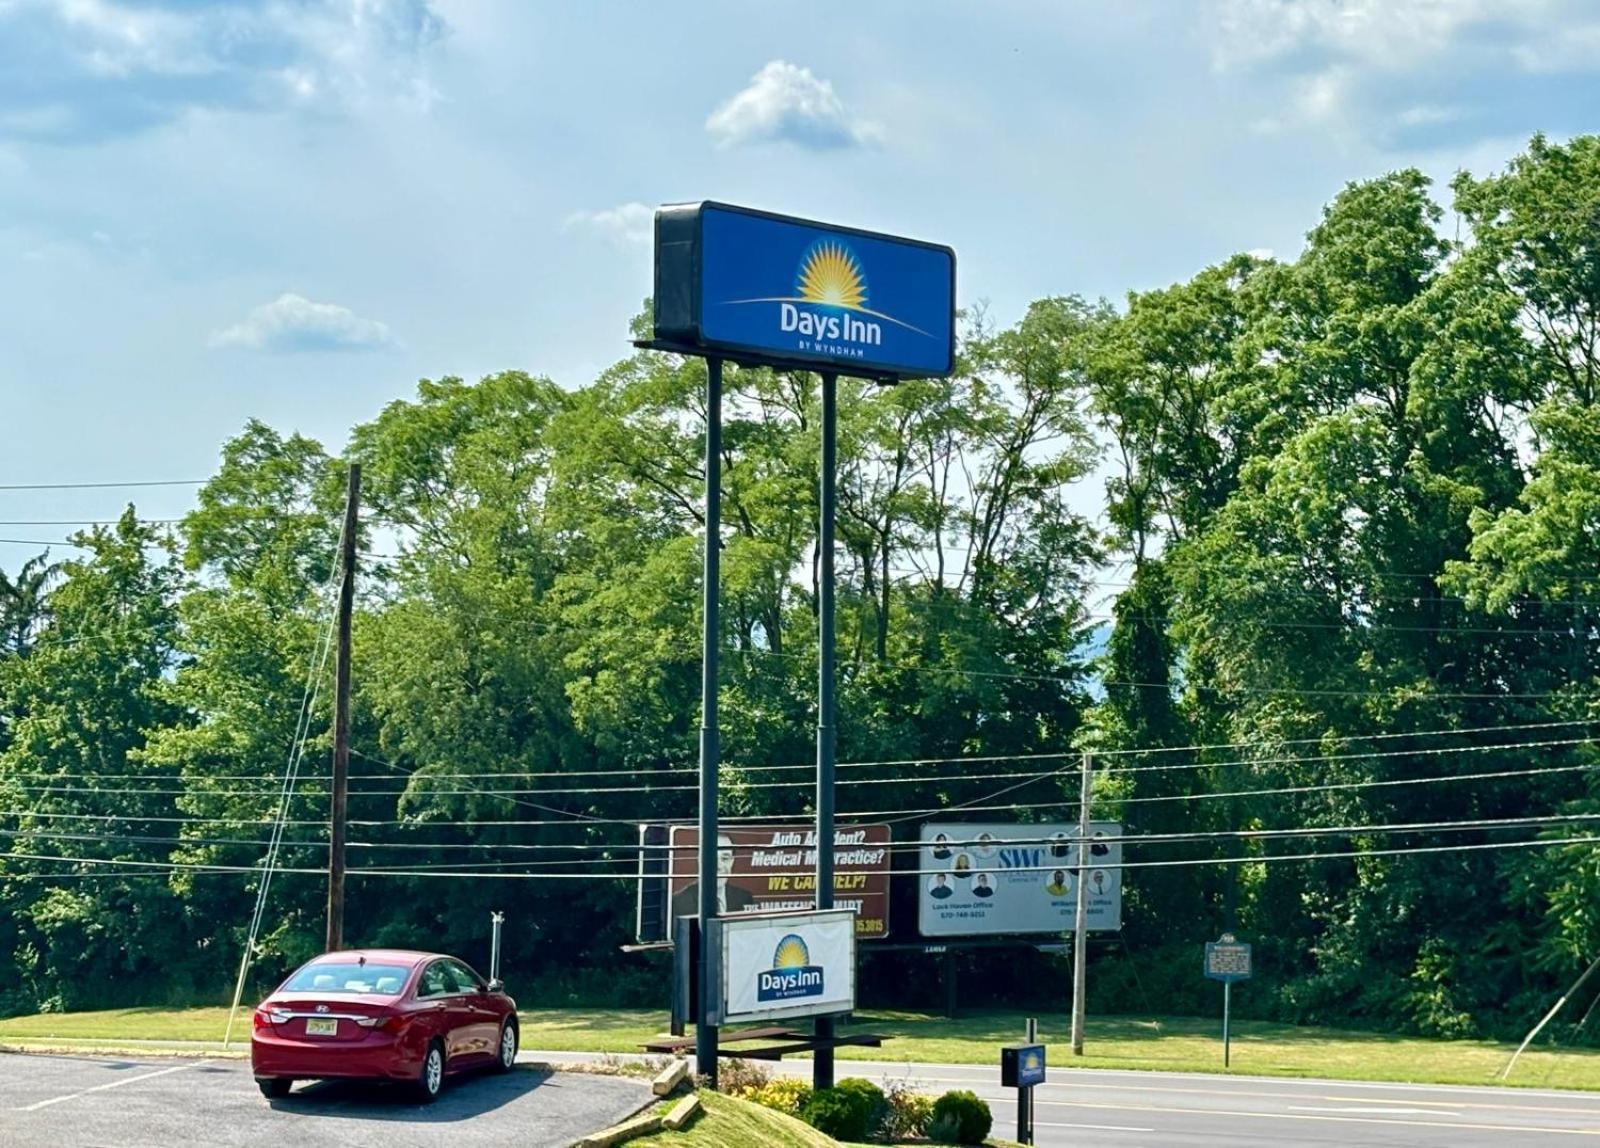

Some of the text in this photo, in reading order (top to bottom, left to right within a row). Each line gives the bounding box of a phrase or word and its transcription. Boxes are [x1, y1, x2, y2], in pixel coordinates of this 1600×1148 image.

[781, 303, 881, 345] Days Inn
[799, 340, 864, 358] BY WYNDHAM
[771, 831, 802, 846] Auto
[751, 849, 885, 867] Medical Mractice?
[999, 848, 1046, 869] SWC
[768, 875, 790, 890] WE
[794, 875, 817, 889] CA
[762, 970, 820, 991] Days Inn
